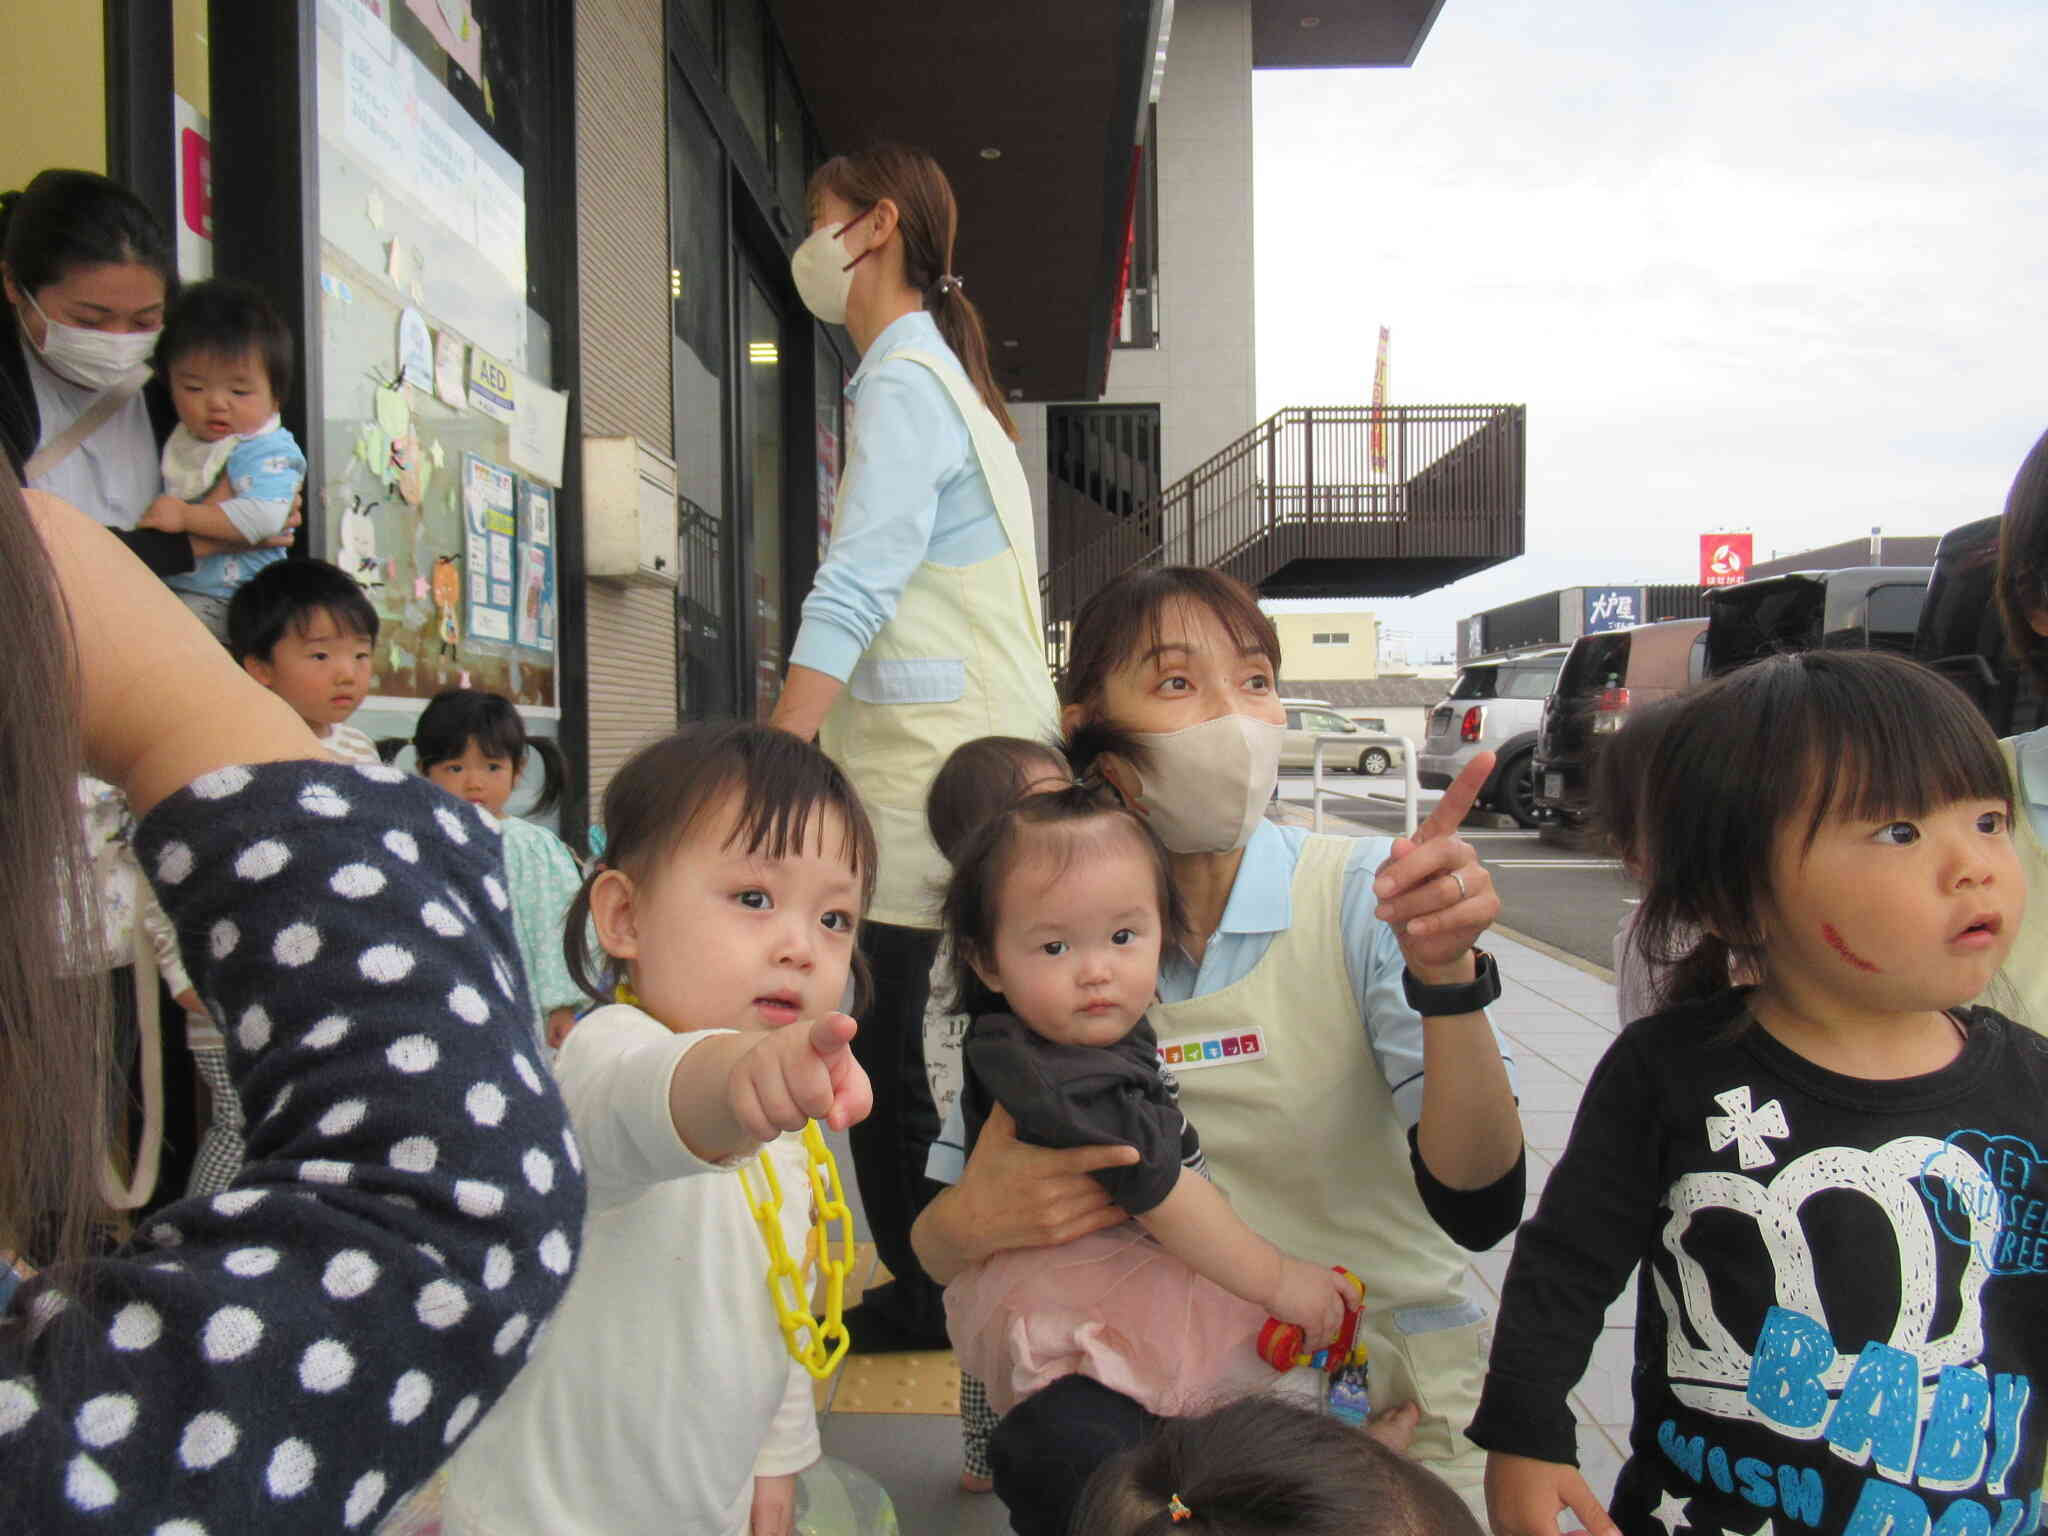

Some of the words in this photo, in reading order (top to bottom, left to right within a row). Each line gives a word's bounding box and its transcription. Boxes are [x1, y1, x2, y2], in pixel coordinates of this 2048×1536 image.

[480, 360, 506, 391] AED
[1590, 592, 1635, 624] 大戸屋
[1978, 1147, 2032, 1190] SET
[1657, 1419, 1825, 1528] WISH
